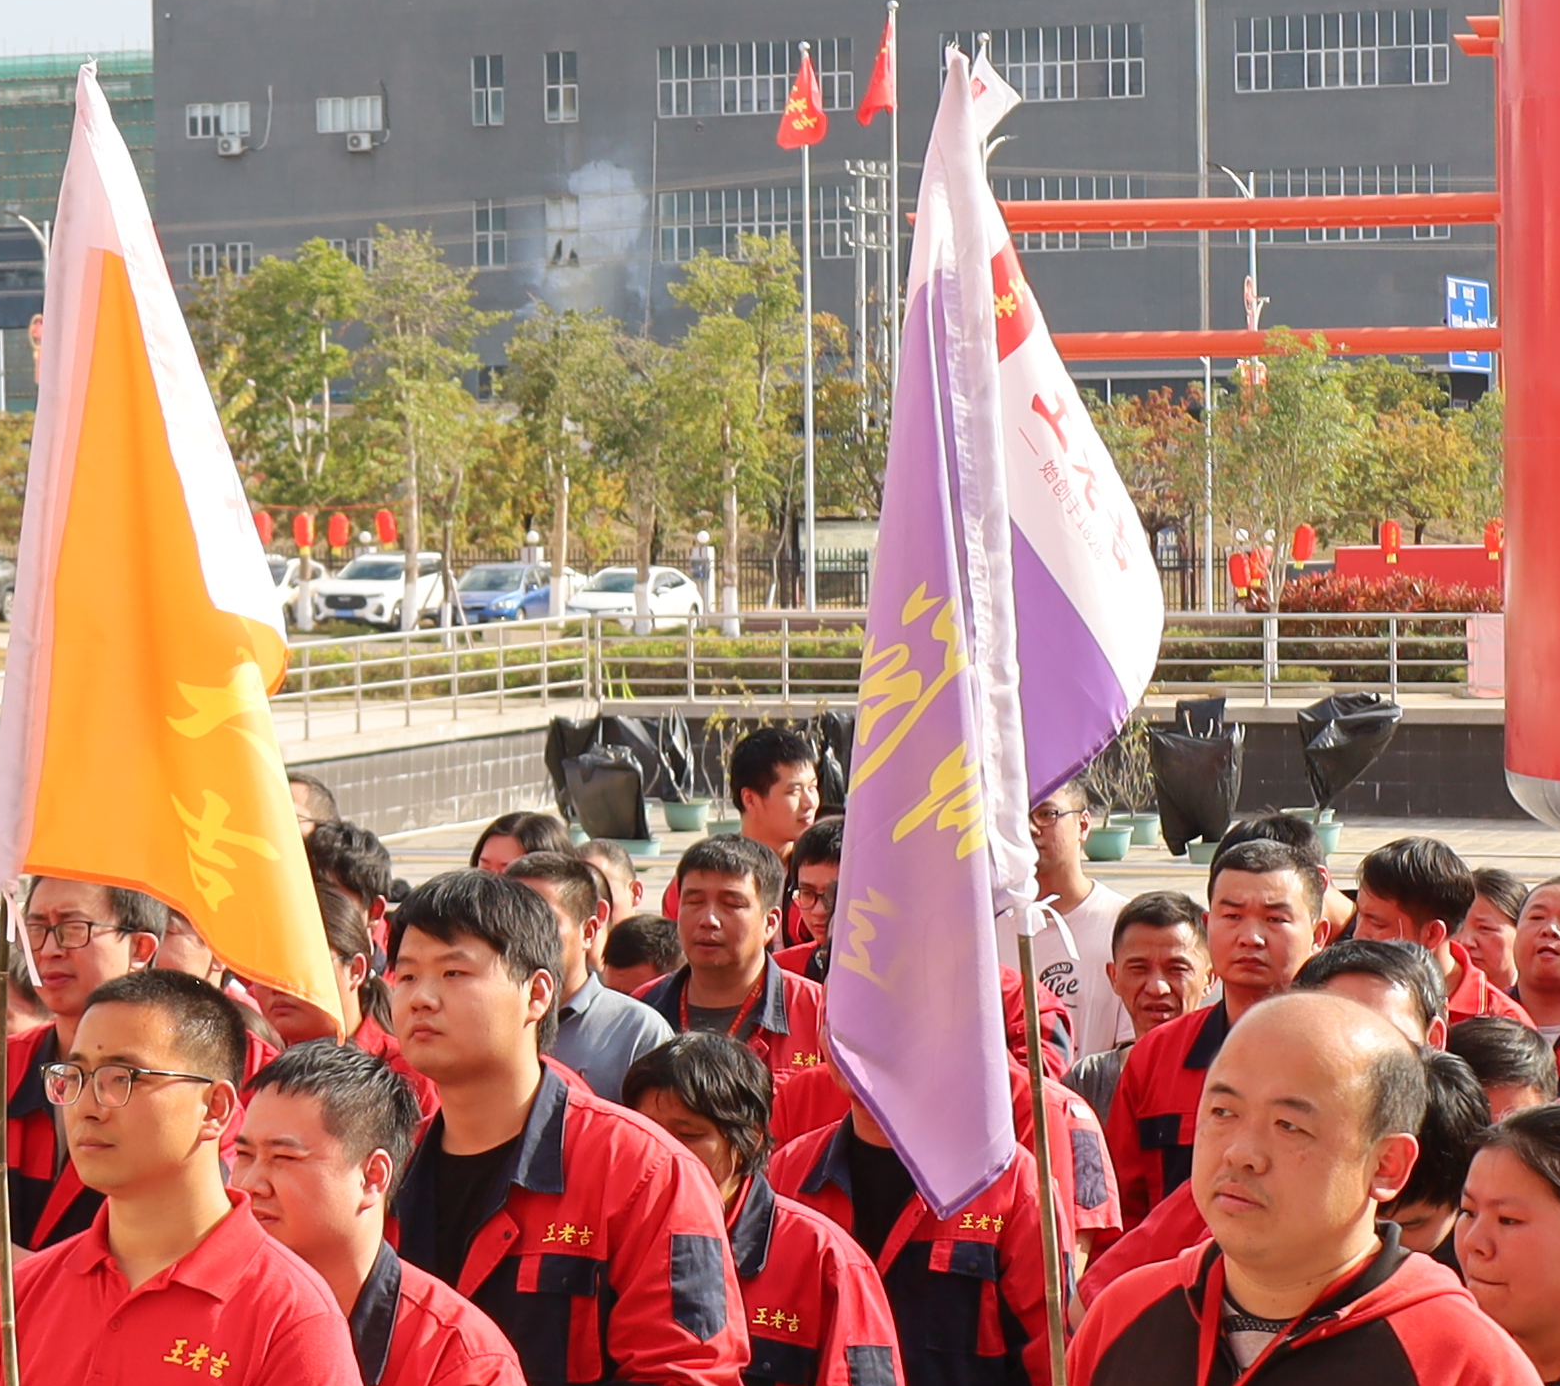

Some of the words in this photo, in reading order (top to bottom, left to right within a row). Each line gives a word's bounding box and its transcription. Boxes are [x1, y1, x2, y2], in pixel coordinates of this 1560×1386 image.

[791, 1051, 818, 1067] 王老
[959, 1212, 1004, 1233] 王老吉
[542, 1223, 593, 1246] 王老吉
[751, 1306, 797, 1330] 王老吉
[163, 1338, 230, 1379] 王老吉
